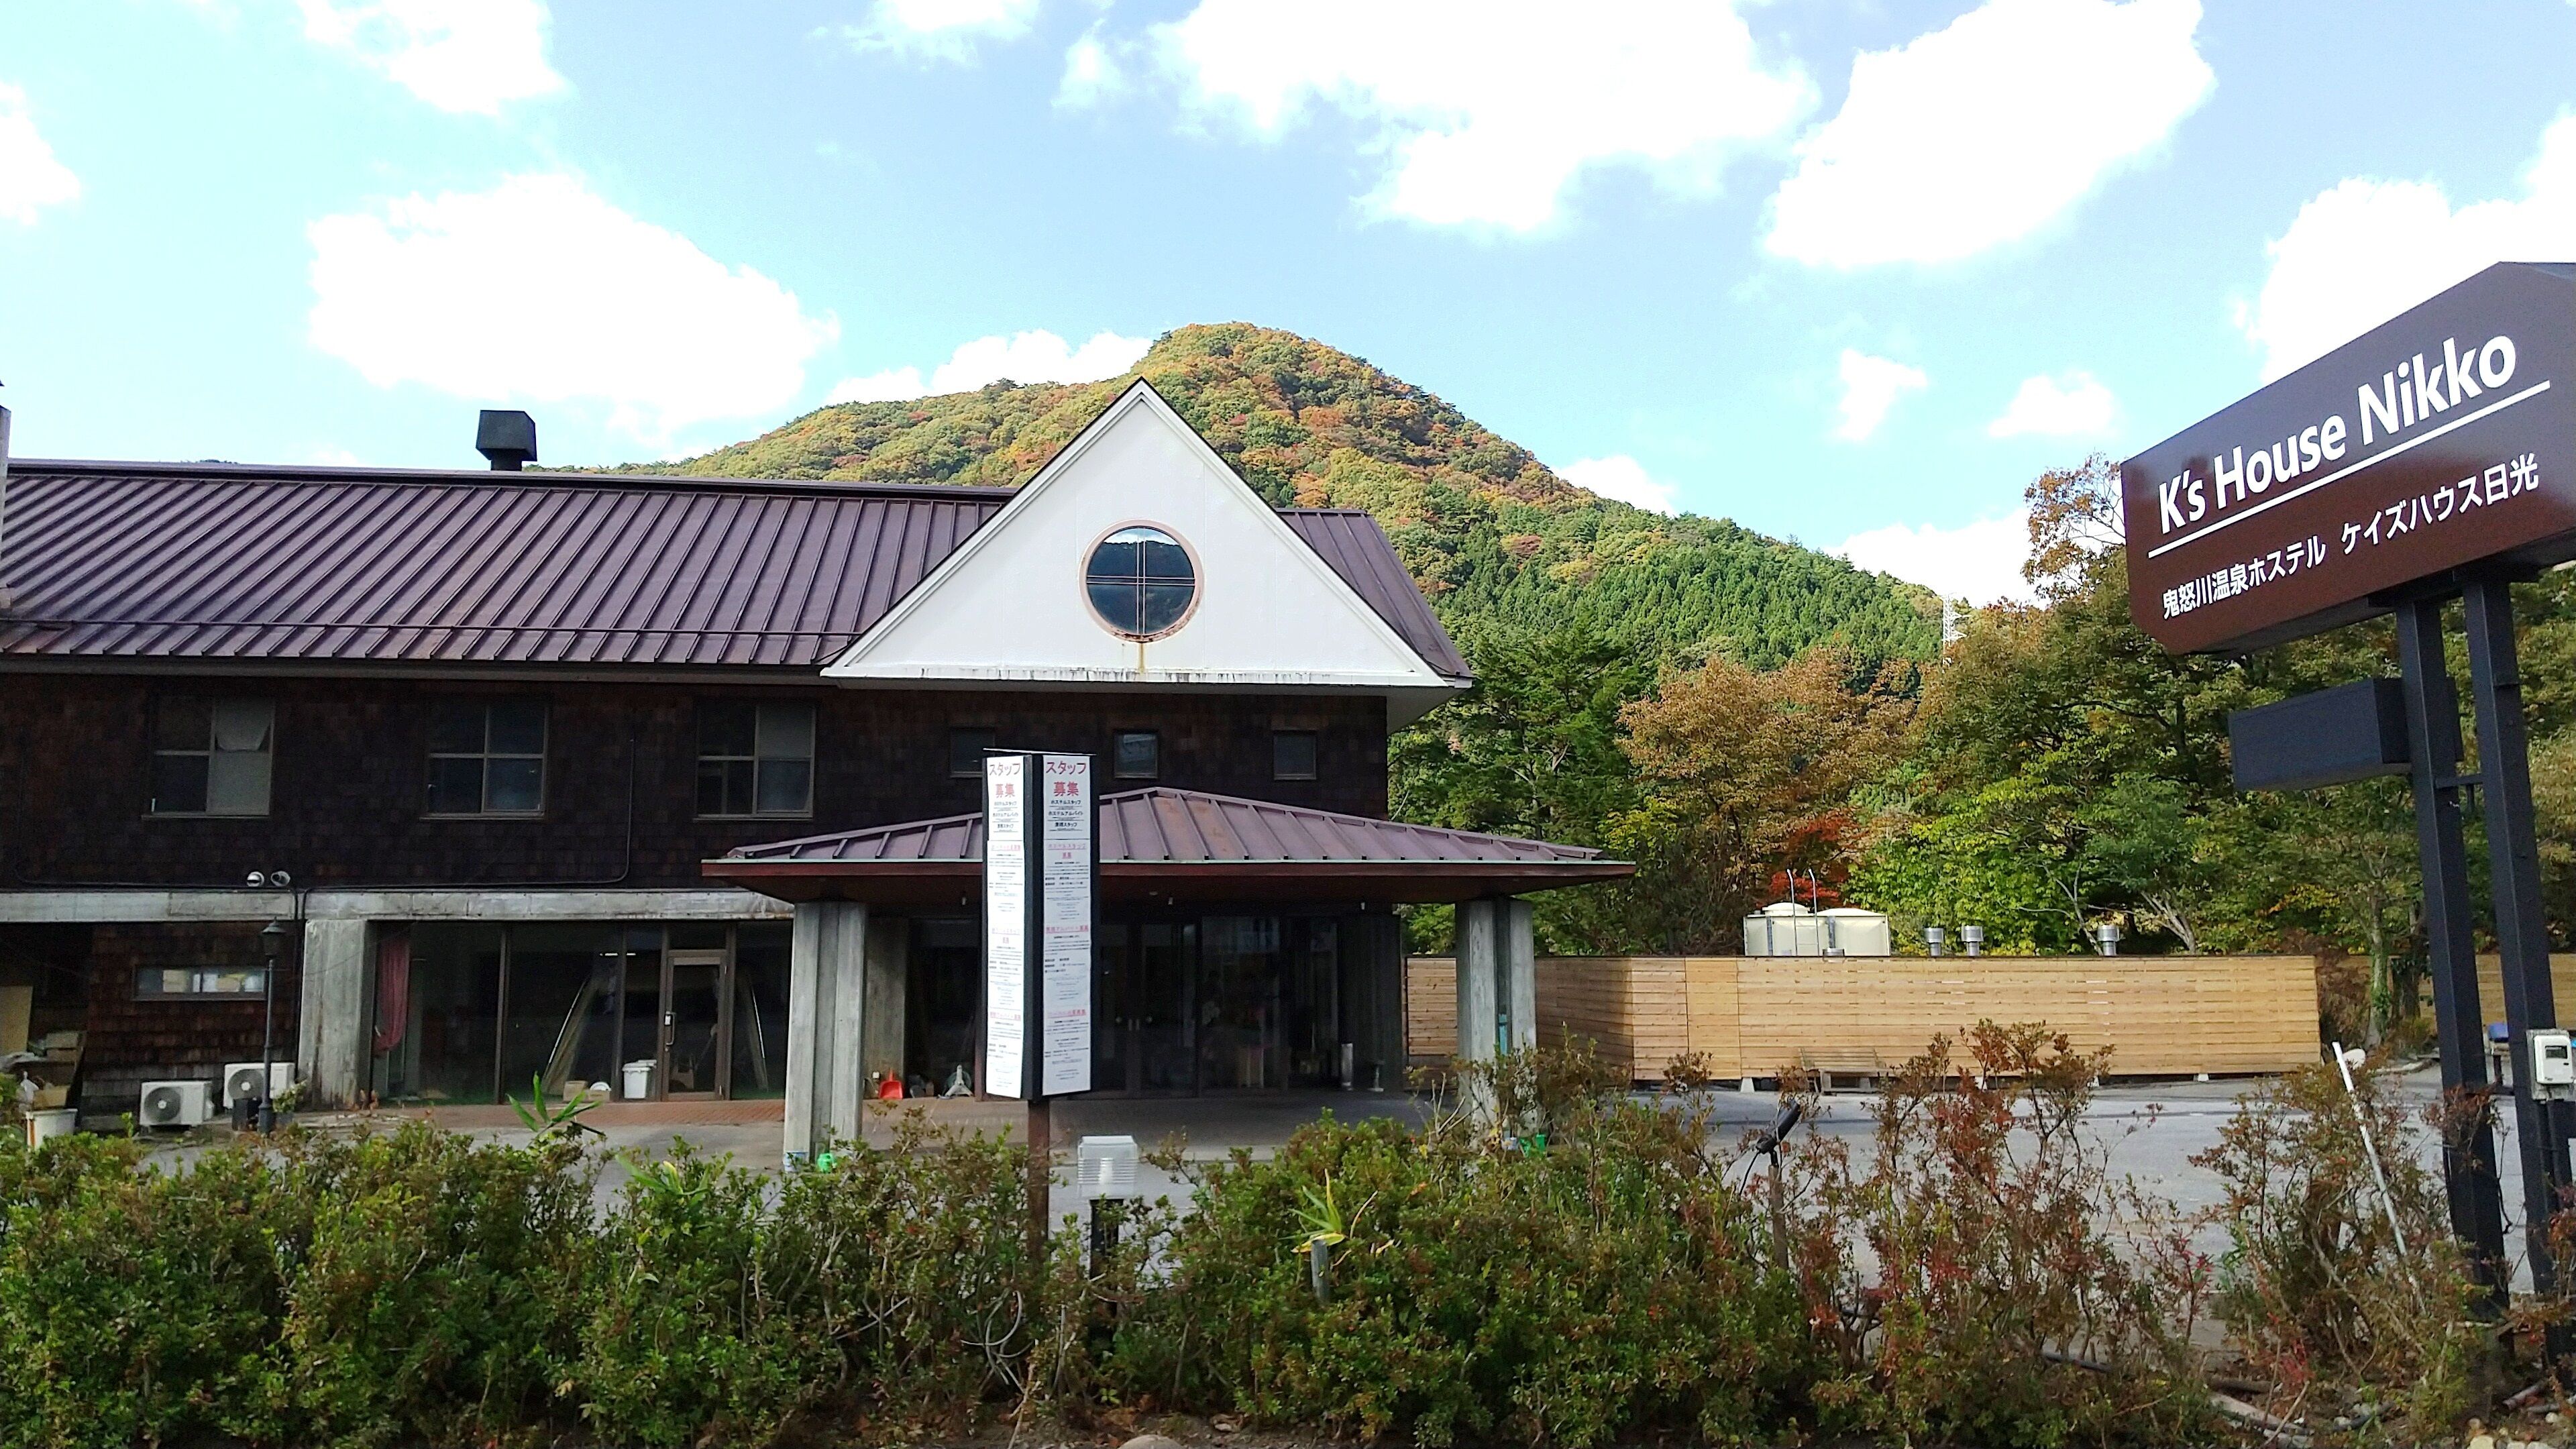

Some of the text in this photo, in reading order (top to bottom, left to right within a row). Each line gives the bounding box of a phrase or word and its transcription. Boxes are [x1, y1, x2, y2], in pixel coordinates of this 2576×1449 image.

[2158, 335, 2516, 535] K's House Nikko
[2162, 453, 2539, 620] 鬼怒川温泉ホステル ケイズハウス日光
[989, 762, 1021, 776] スタッフ
[1046, 761, 1087, 775] スタッフ
[1053, 782, 1079, 796] 募集
